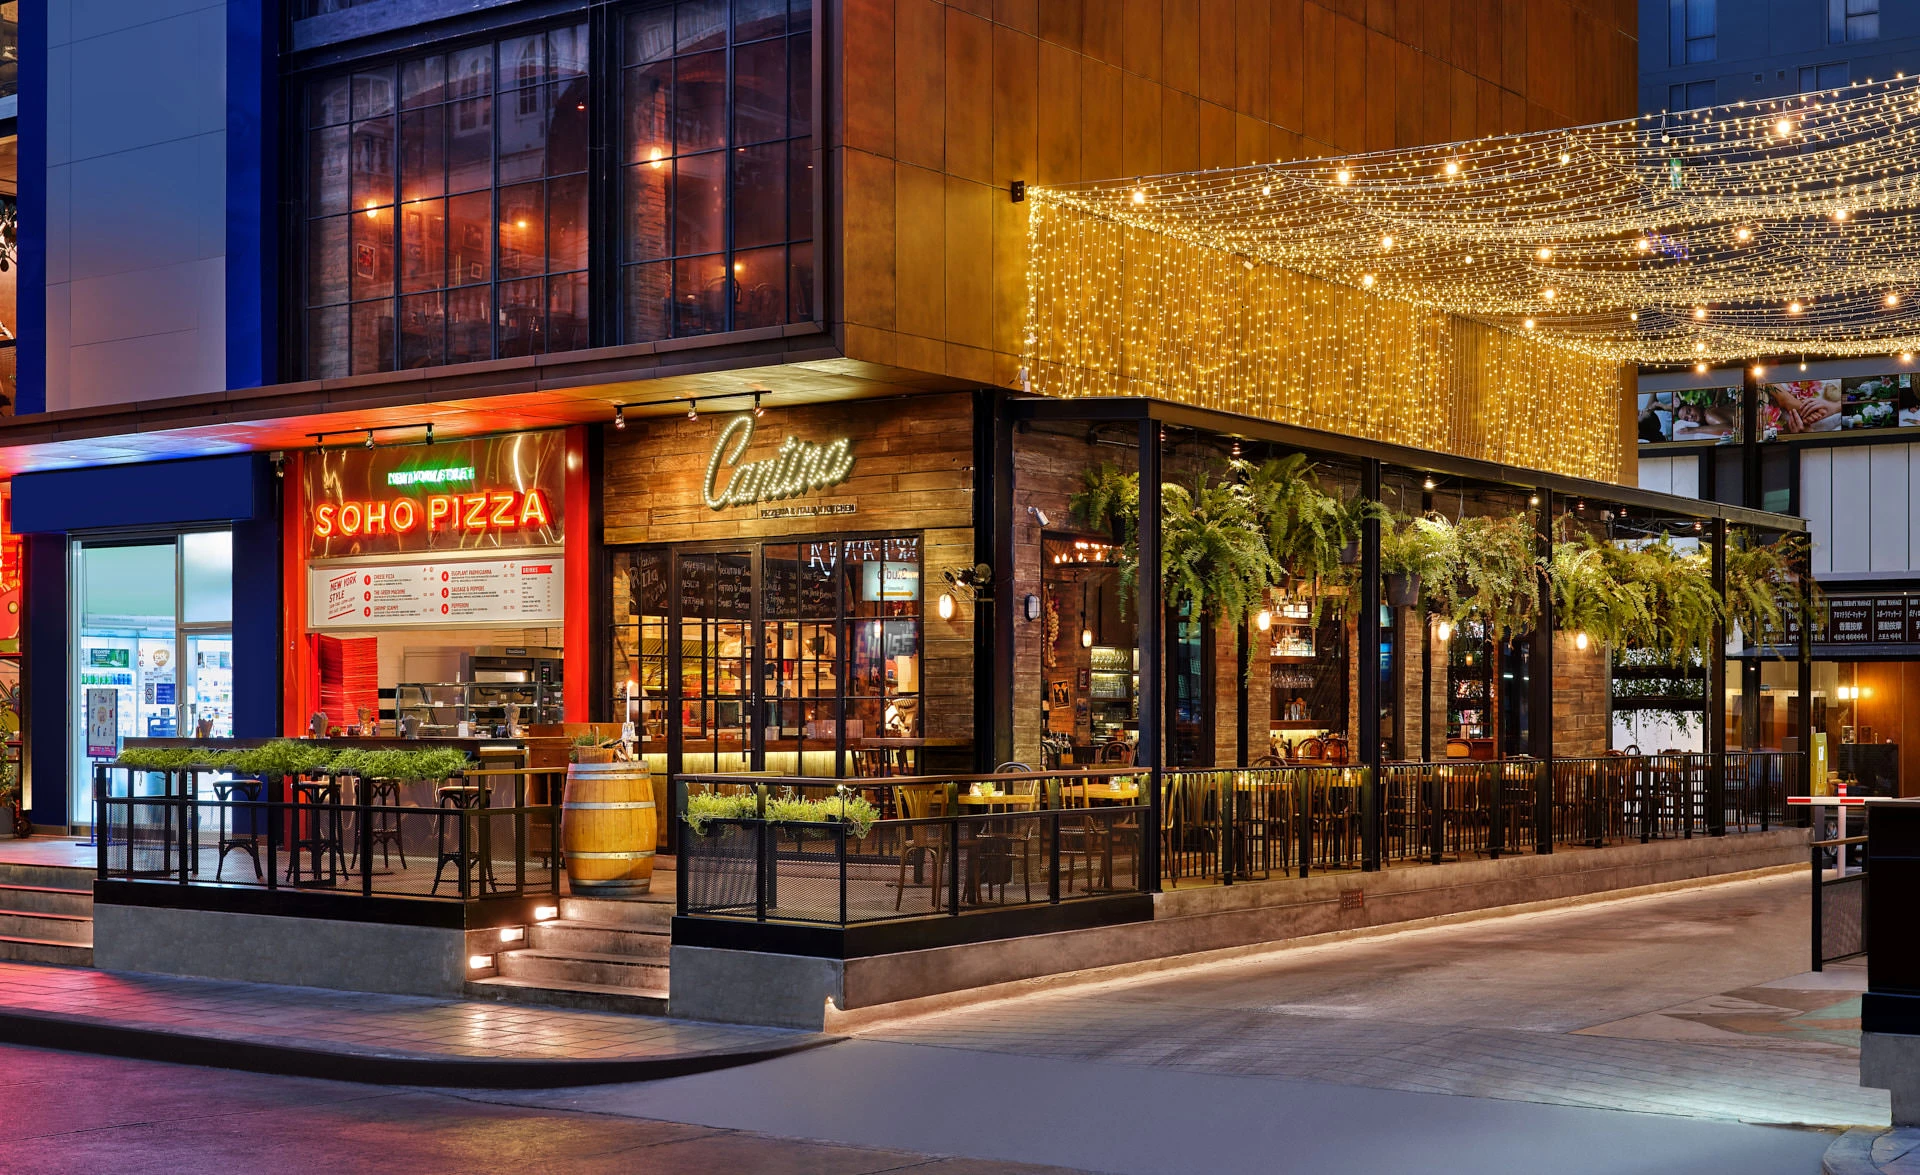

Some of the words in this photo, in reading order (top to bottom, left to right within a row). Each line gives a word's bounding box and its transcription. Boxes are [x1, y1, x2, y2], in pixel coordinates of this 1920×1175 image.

[703, 415, 857, 511] Cantina
[314, 497, 424, 538] SOHO
[427, 488, 556, 532] PIZZA
[823, 504, 856, 514] KITCHEN
[329, 579, 342, 592] NEW
[343, 575, 358, 587] YORK
[328, 590, 345, 603] STYLE
